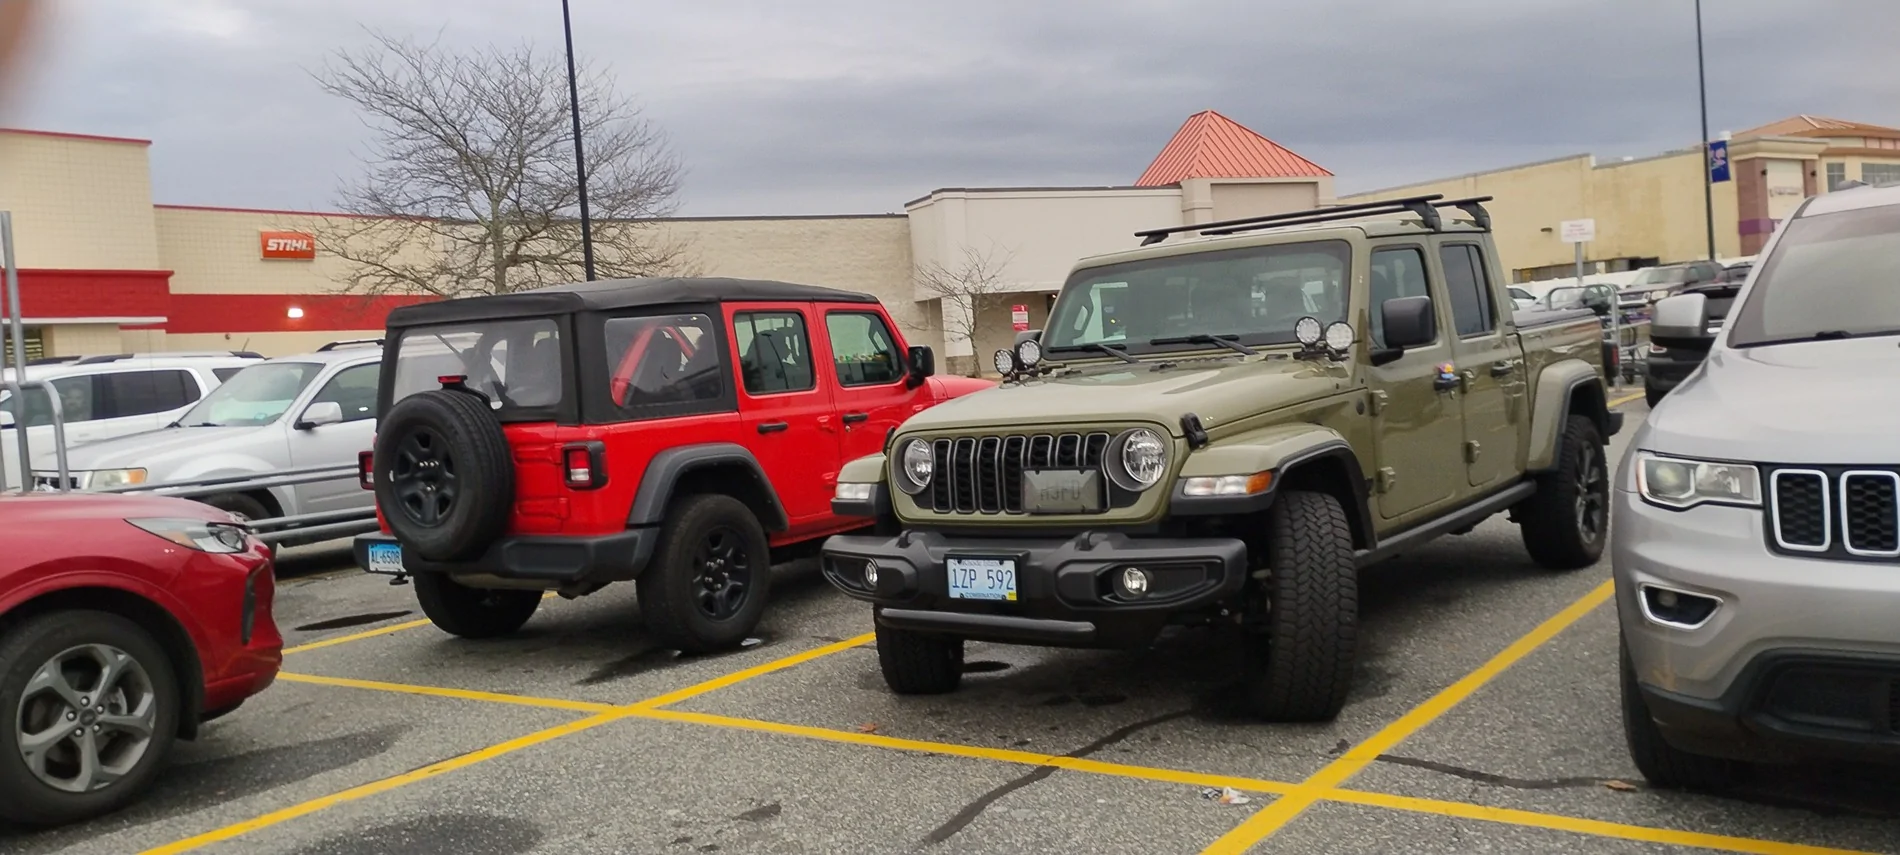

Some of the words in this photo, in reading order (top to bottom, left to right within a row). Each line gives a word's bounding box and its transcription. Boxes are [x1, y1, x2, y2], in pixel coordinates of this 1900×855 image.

[266, 238, 312, 251] STIHL
[952, 568, 977, 589] 1ZP
[987, 569, 1014, 590] 592
